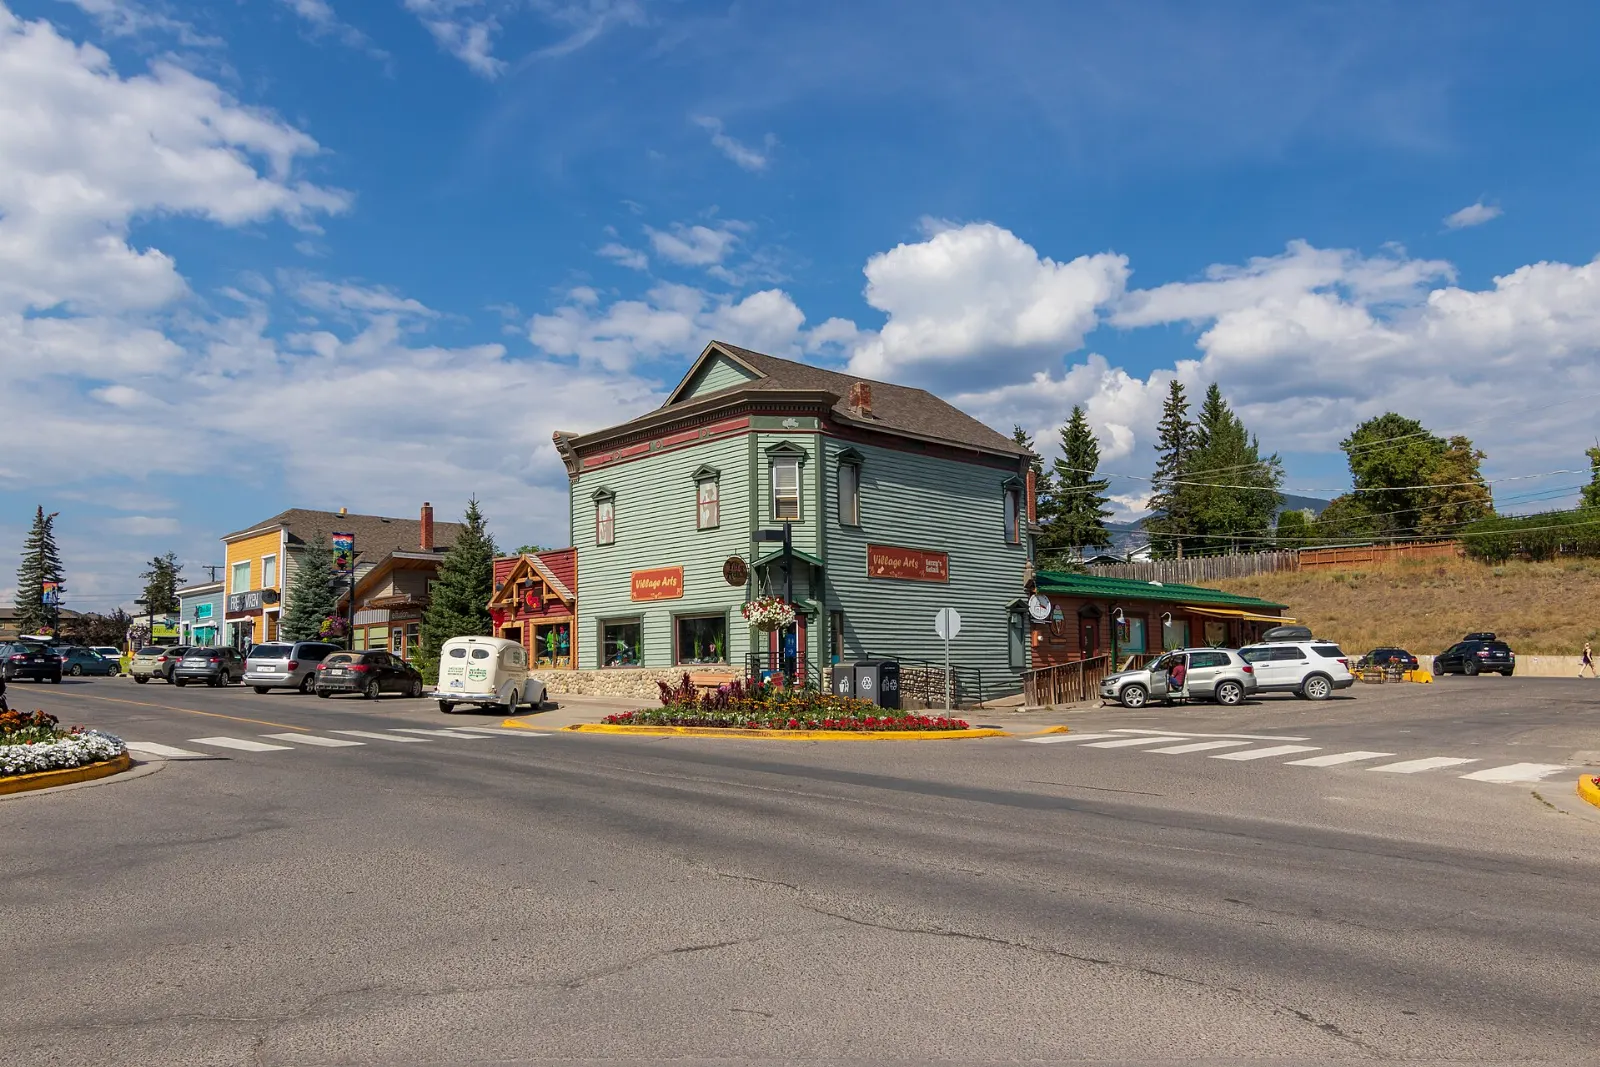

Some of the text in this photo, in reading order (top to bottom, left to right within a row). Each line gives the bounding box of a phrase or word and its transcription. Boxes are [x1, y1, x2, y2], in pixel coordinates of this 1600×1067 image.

[873, 554, 919, 569] Village Arts
[635, 576, 677, 590] Village Arts
